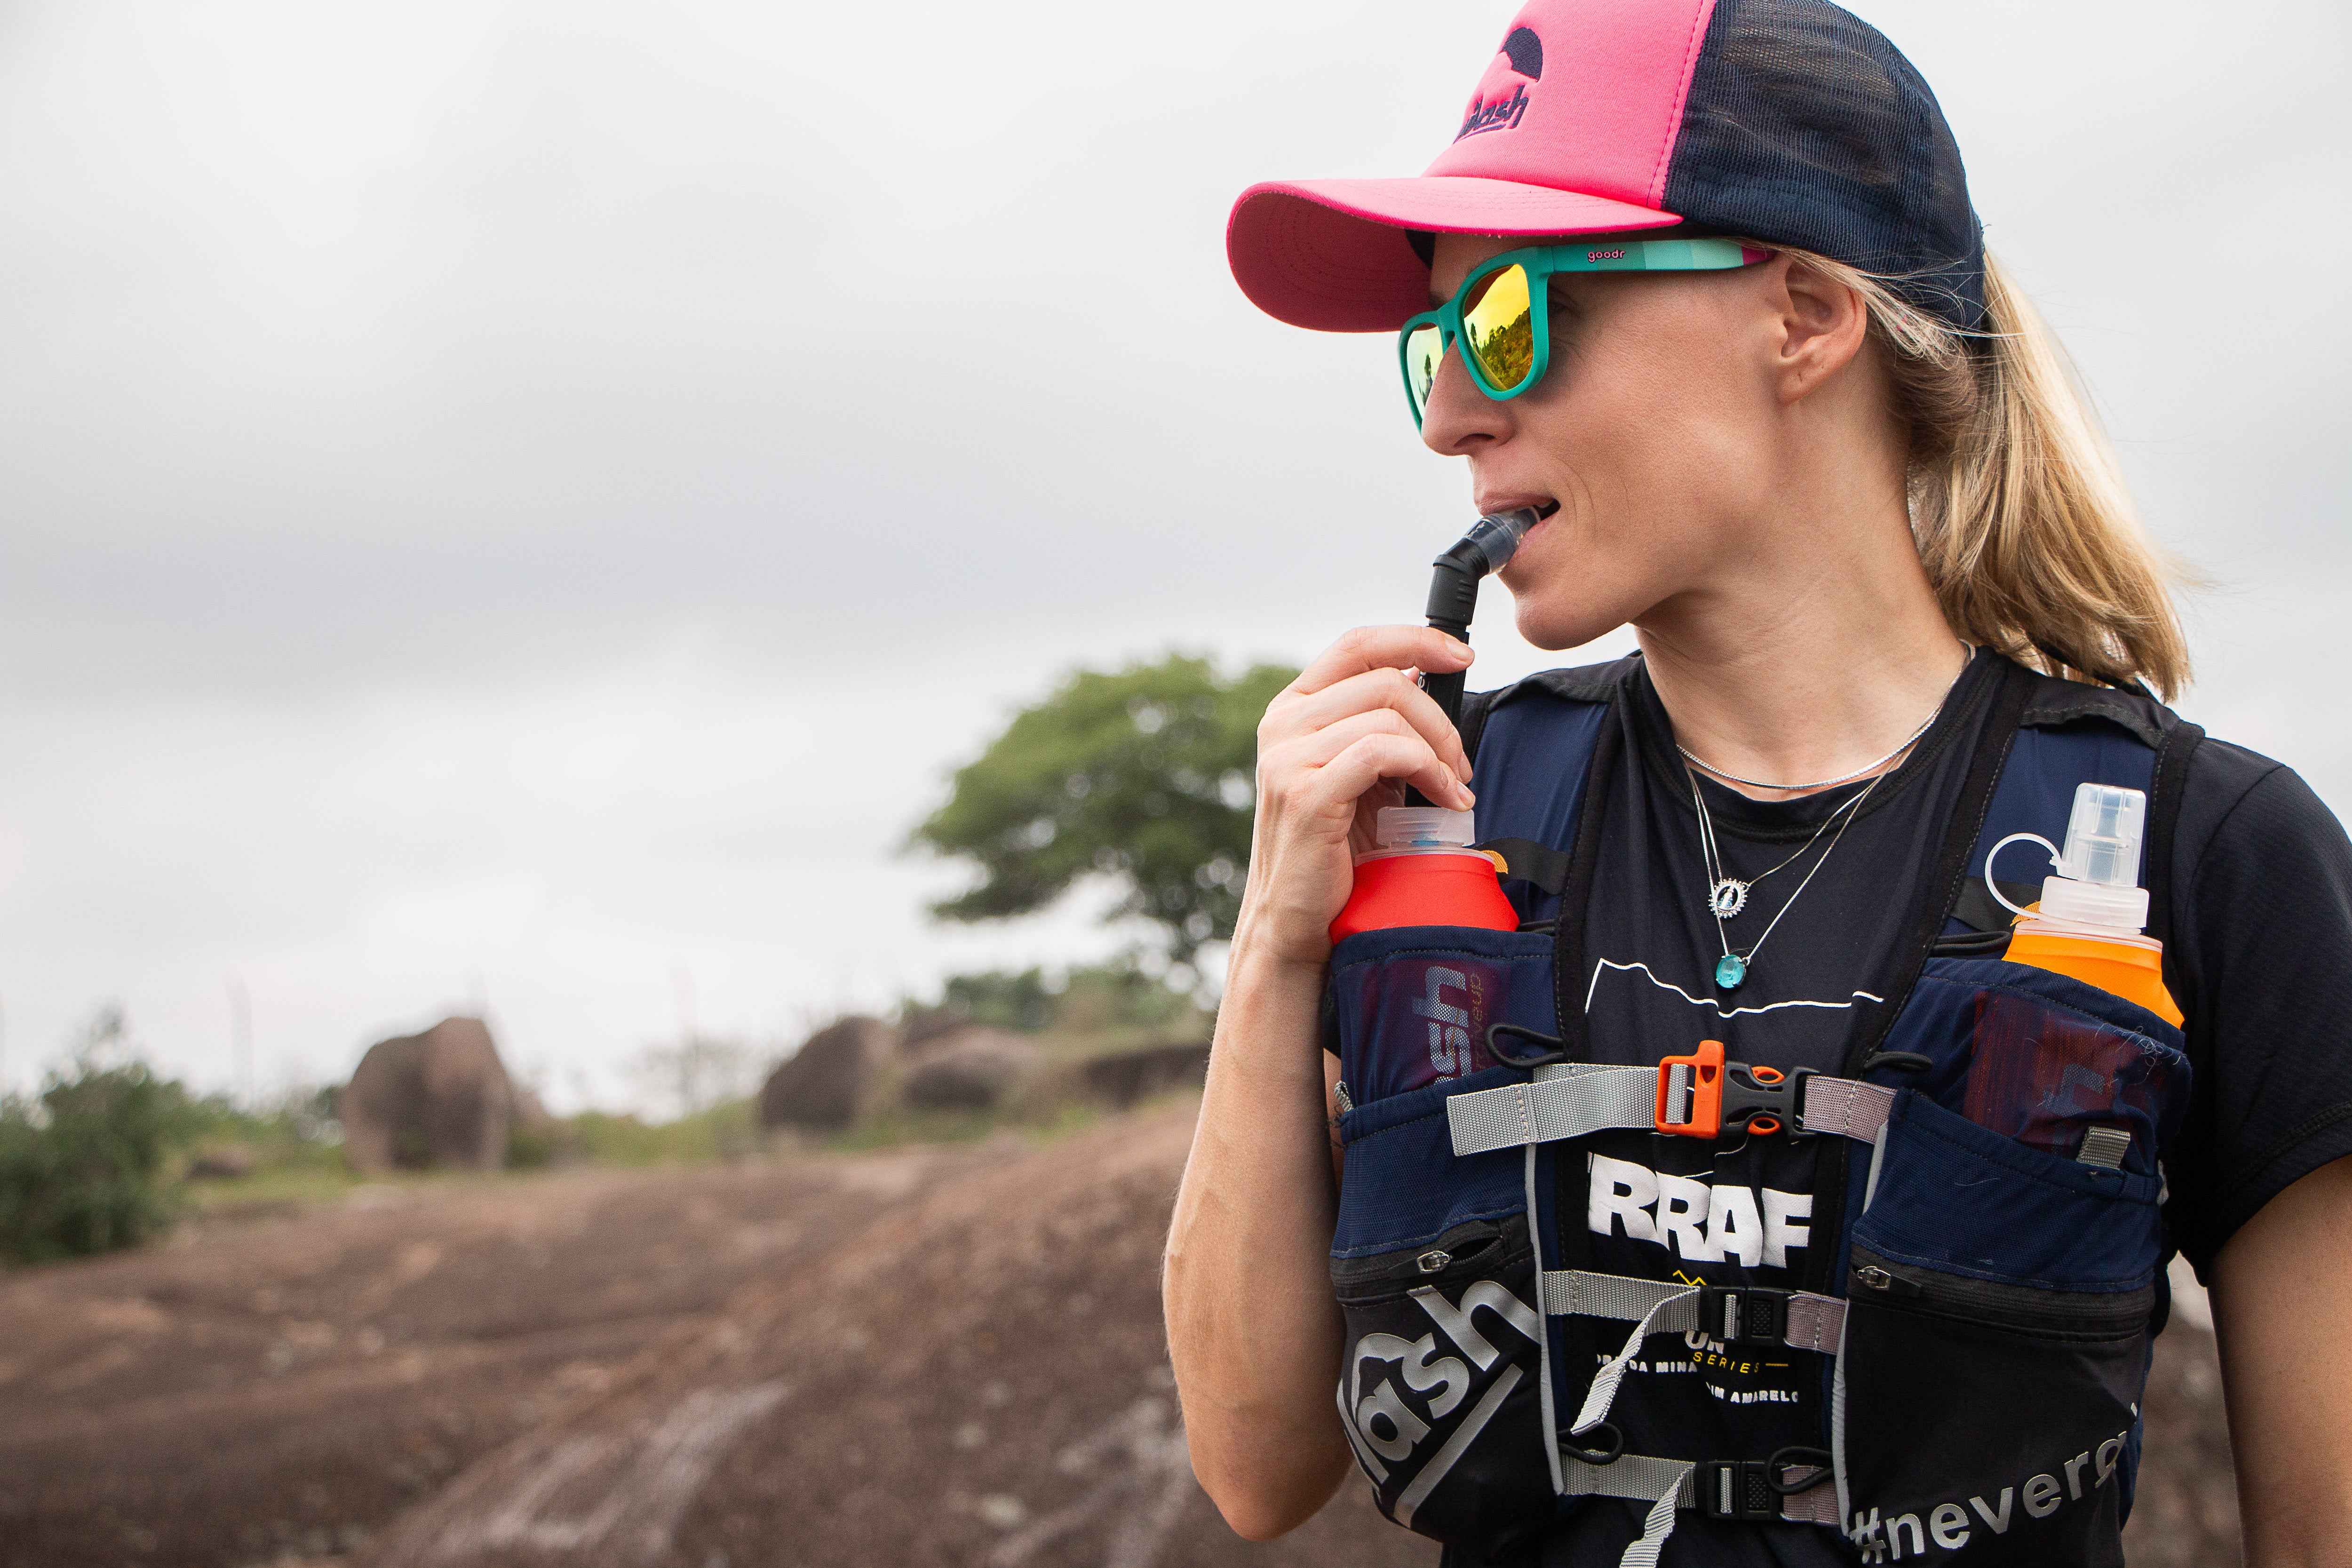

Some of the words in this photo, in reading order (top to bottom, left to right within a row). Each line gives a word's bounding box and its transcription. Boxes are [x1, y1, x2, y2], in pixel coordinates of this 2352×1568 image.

[1588, 249, 1626, 263] goodr
[1588, 1152, 1813, 1268] RRAF
[1656, 1361, 1698, 1373] MINA
[1693, 1352, 1760, 1373] SERIES
[1850, 1402, 2137, 1564] #neverg
